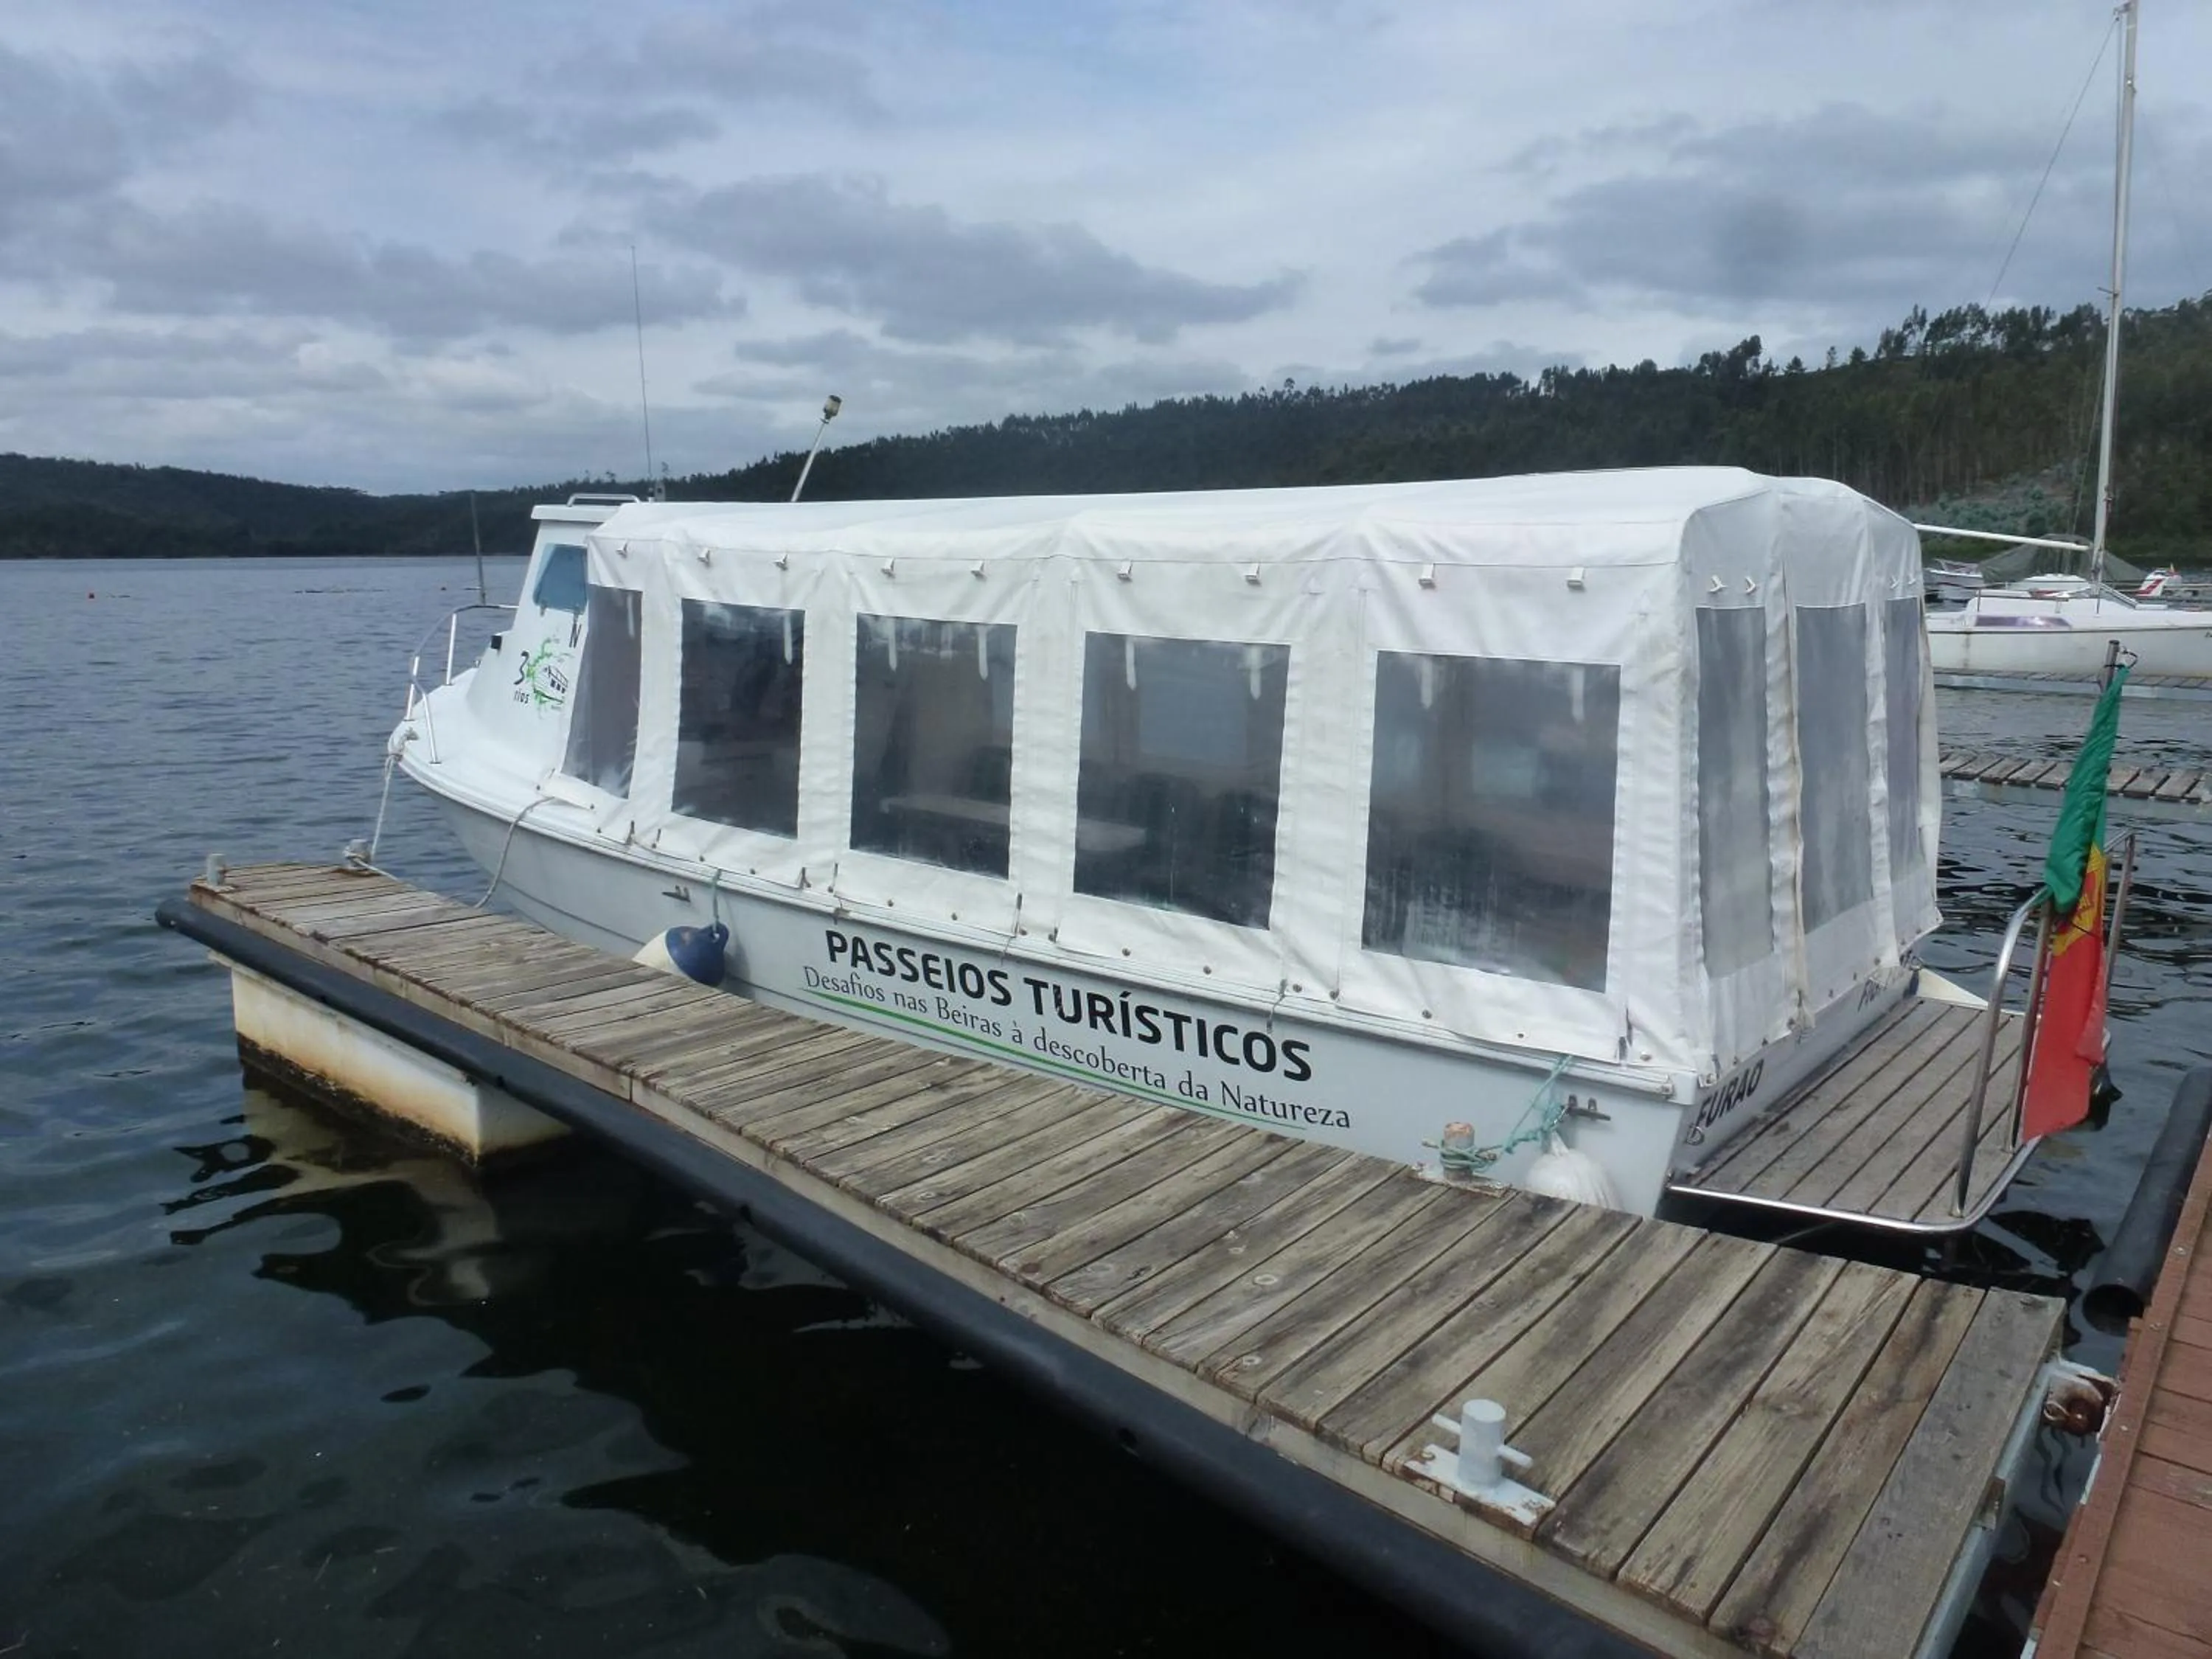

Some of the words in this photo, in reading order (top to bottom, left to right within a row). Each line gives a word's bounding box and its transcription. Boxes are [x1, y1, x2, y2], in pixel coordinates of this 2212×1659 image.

[803, 965, 886, 1002] Desafios
[893, 991, 928, 1014] nas
[936, 996, 1003, 1038] Beiras
[1012, 1020, 1023, 1045] à
[1034, 1026, 1166, 1090] descoberta
[1178, 1070, 1208, 1101] da
[1220, 1080, 1351, 1129] Natureza
[825, 930, 1012, 1006] PASSEIOS
[1023, 977, 1312, 1082] TURÍSTICOS
